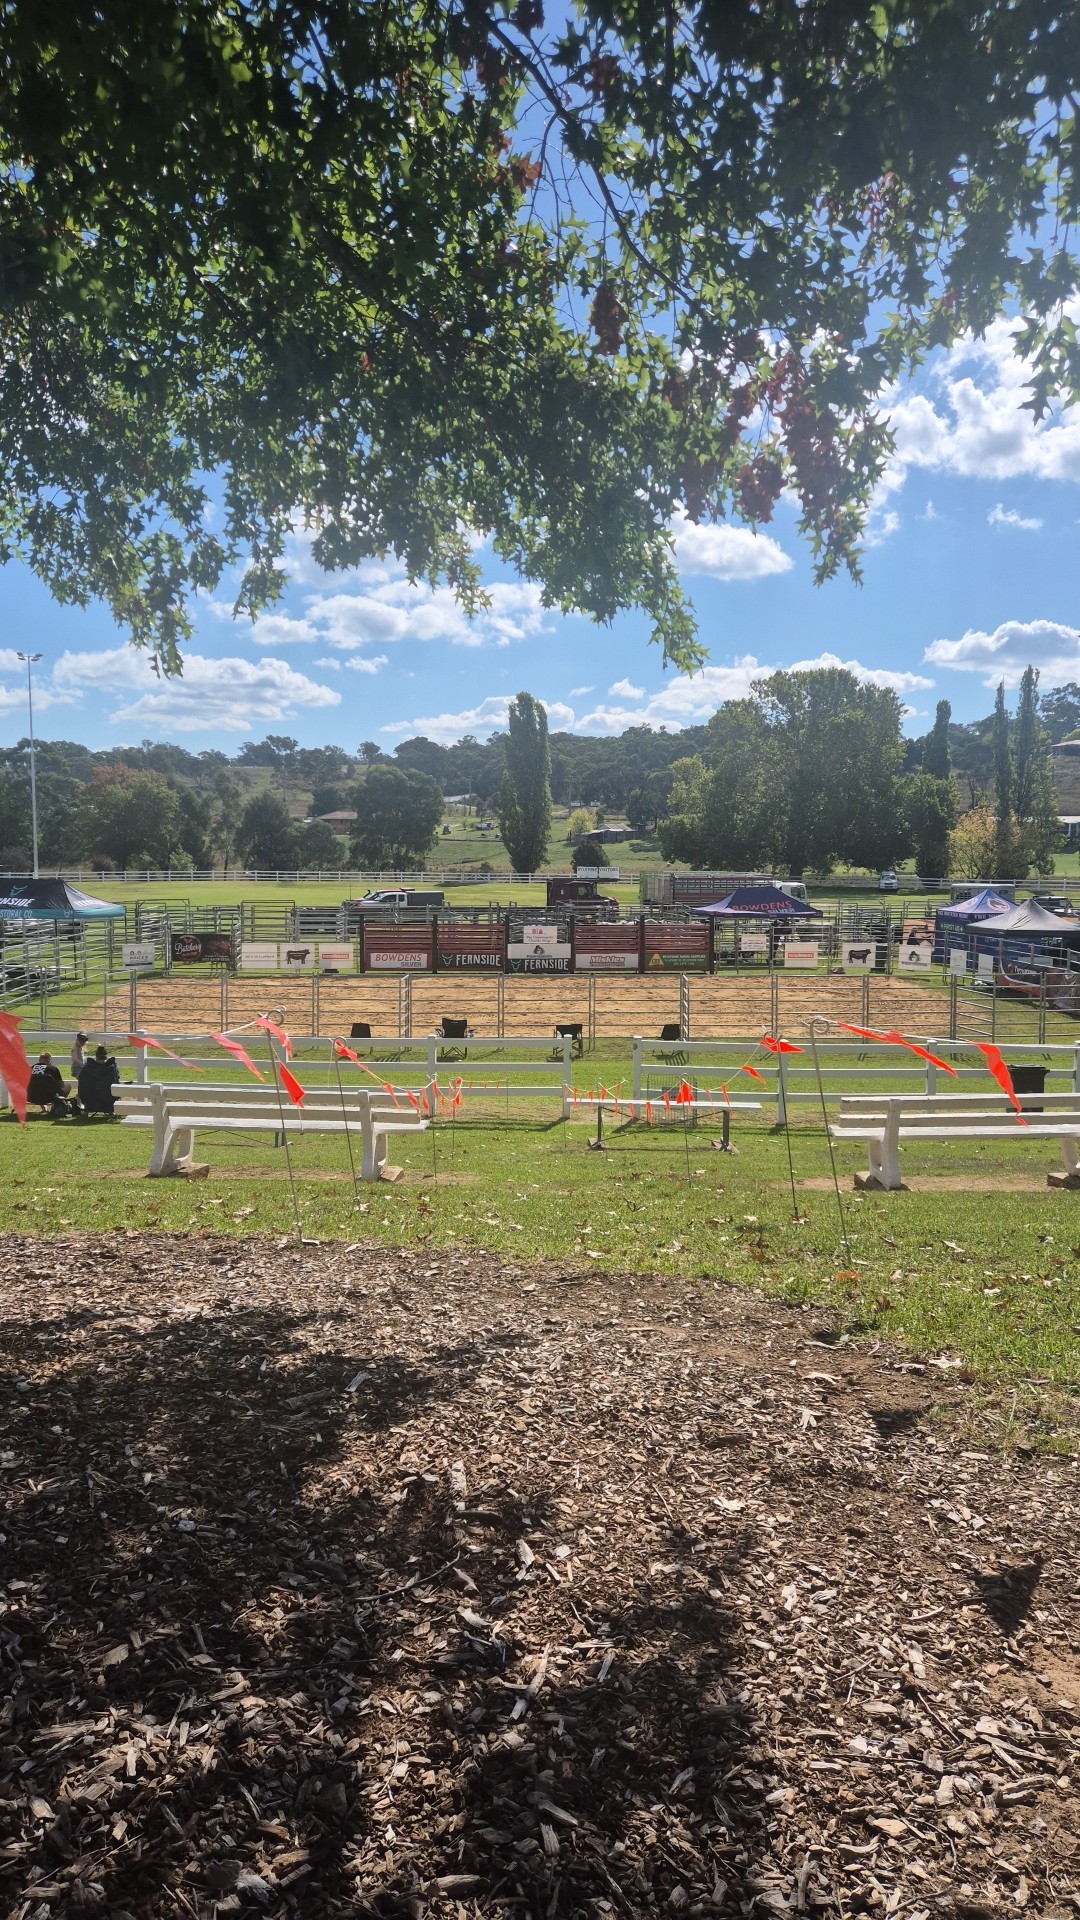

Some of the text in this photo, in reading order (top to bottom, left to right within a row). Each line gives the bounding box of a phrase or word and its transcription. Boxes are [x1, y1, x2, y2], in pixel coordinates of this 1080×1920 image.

[732, 901, 792, 912] BOWDENS
[175, 942, 202, 954] Butchery
[375, 953, 422, 961] BOWDENS
[456, 954, 501, 966] FERNSIDE
[524, 959, 569, 971] FERNSIDE
